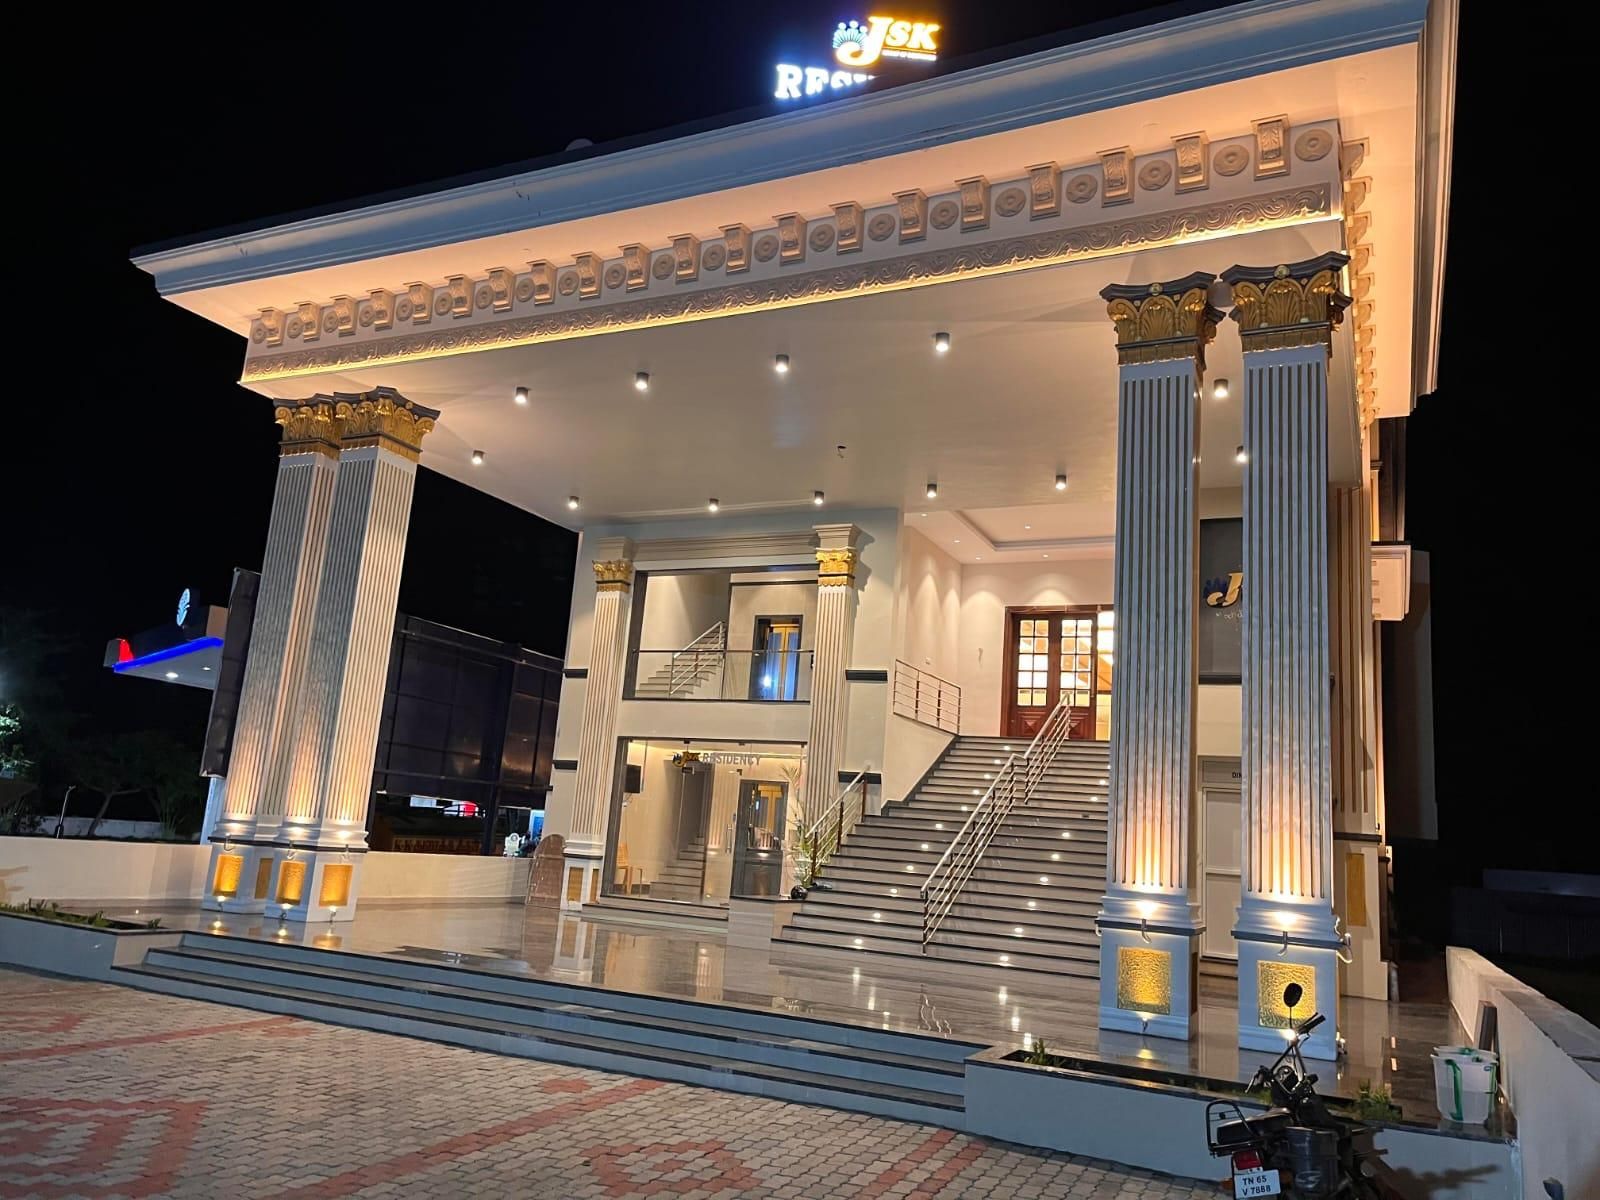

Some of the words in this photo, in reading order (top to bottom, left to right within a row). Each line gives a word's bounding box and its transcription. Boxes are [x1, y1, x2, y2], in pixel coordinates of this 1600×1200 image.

[836, 16, 940, 65] JSK
[702, 753, 760, 766] RESIDENCY
[1242, 1177, 1254, 1186] TN
[1256, 1175, 1267, 1184] 65
[1241, 1188, 1248, 1196] V
